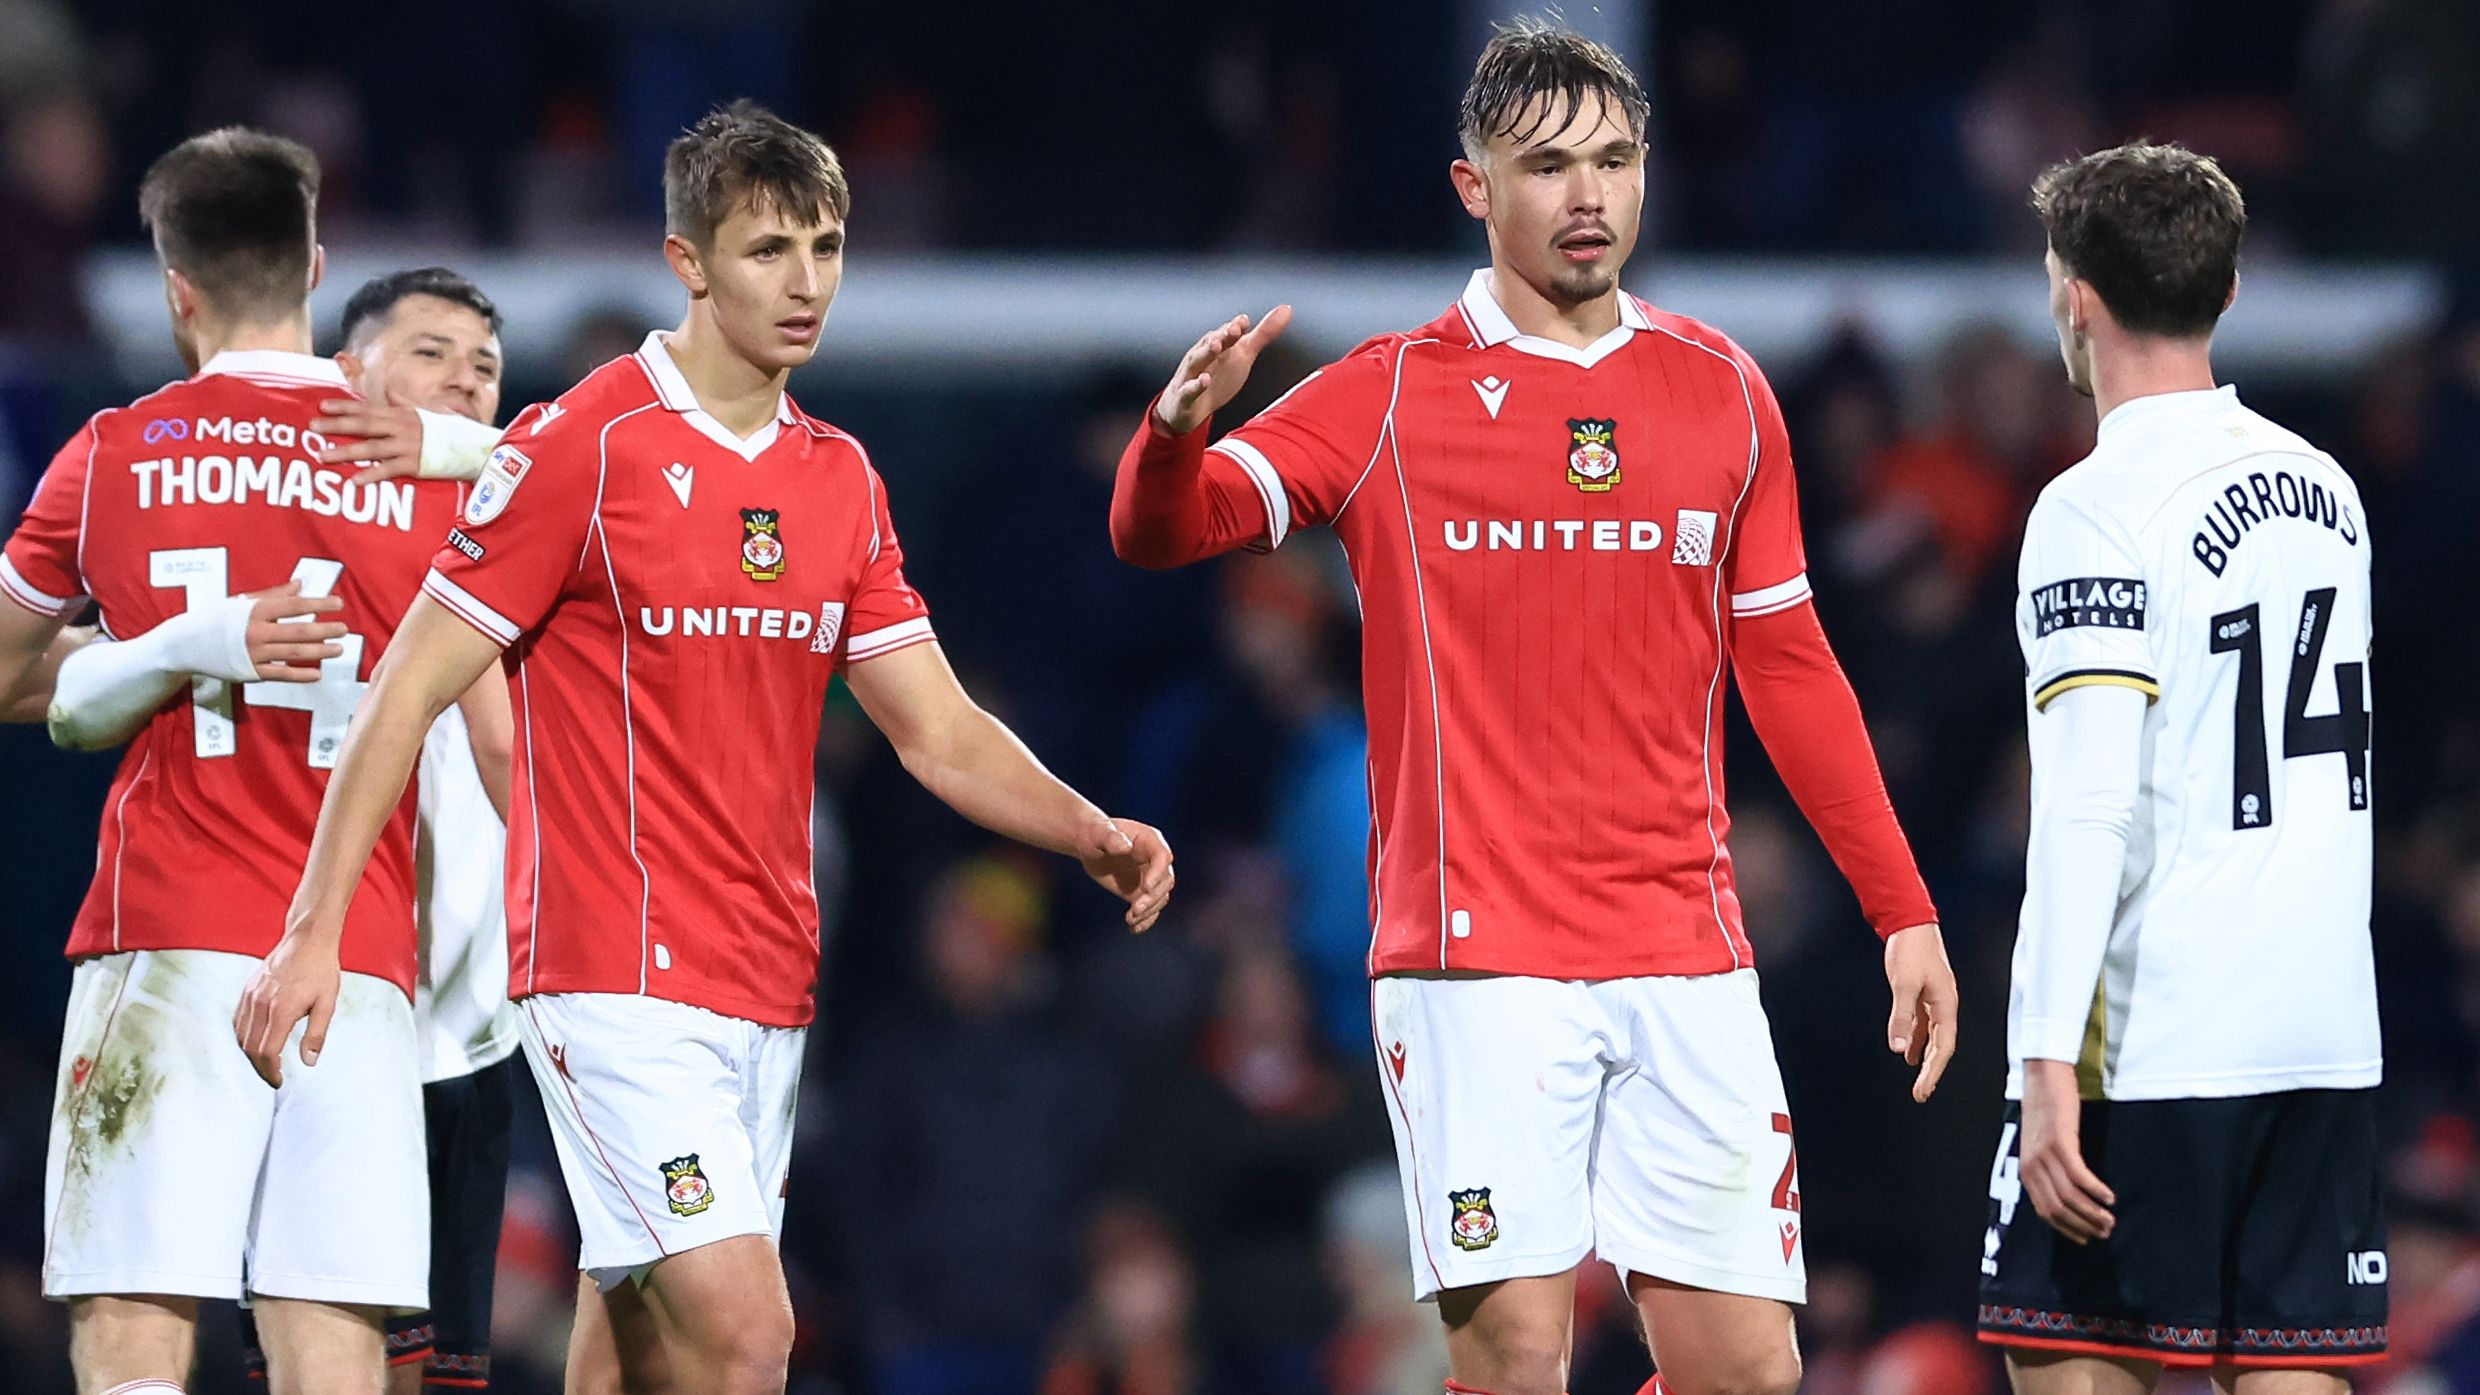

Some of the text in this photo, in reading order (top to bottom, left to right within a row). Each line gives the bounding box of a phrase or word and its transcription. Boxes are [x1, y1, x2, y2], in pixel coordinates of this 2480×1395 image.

[195, 417, 296, 447] Meta
[130, 456, 415, 531] THOMASON
[1444, 521, 1662, 551] UNITED
[2193, 471, 2357, 578] BURROWS
[2035, 581, 2144, 617] VILLAGE
[641, 607, 812, 639] UNITED
[2043, 611, 2135, 632] HOTELS
[2210, 587, 2370, 830] 14
[1989, 1122, 2021, 1225] 4
[2347, 1250, 2388, 1285] NO
